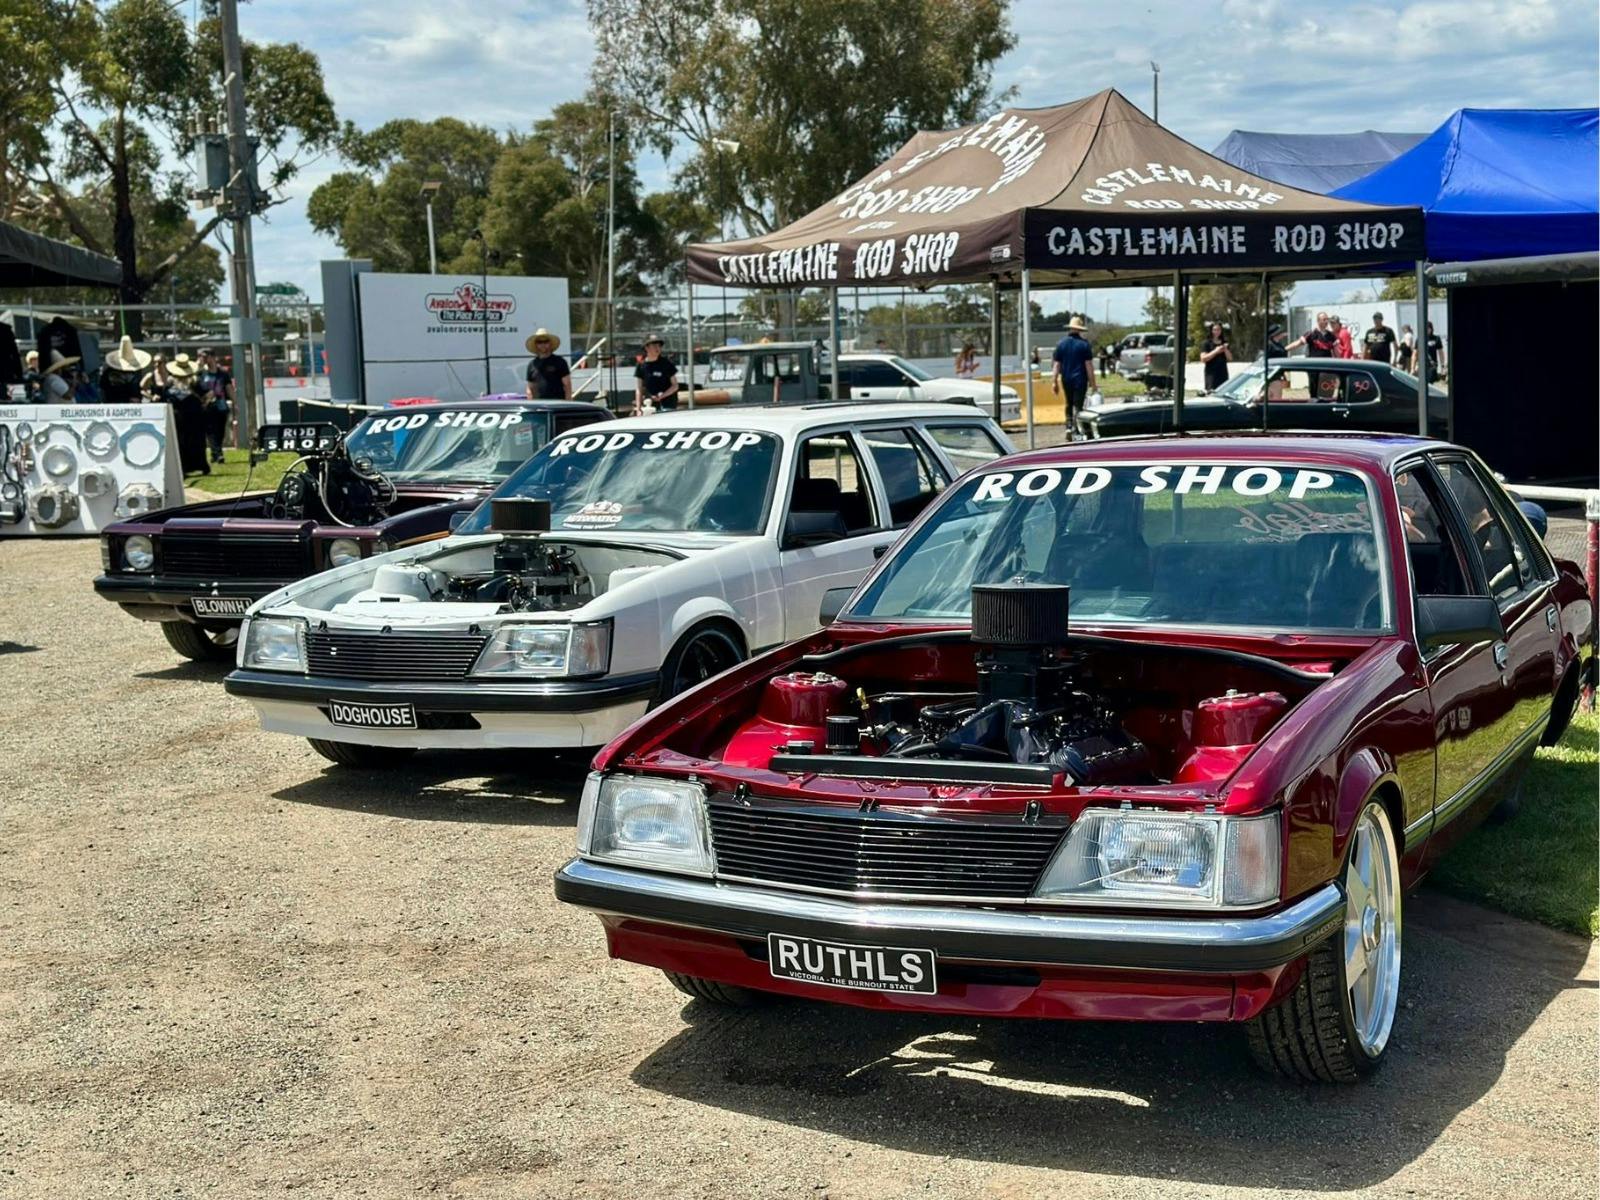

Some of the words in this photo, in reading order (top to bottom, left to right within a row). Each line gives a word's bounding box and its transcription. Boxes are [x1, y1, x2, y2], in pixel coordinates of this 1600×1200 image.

[1081, 163, 1284, 205] CASTLEMAINE
[839, 188, 909, 220] ROD
[898, 185, 983, 214] SHOP
[1123, 199, 1184, 210] ROD
[1189, 199, 1260, 211] SHOP
[1047, 225, 1247, 256] CASTLEMAINE
[1272, 224, 1326, 254] ROD
[1335, 221, 1405, 252] SHOP
[718, 242, 840, 284] CASTLEMAINE
[853, 238, 896, 280] ROD
[901, 231, 960, 276] SHOP
[430, 298, 460, 309] Avalon
[426, 326, 518, 334] avalonracewa.com.au
[60, 408, 105, 418] BELLHOUSINGS
[106, 408, 111, 417] &
[112, 408, 142, 417] ADAPTORS
[366, 413, 429, 435] ROD
[434, 412, 523, 429] SHOP
[283, 427, 316, 438] ROD
[268, 439, 329, 449] SHOP
[550, 432, 635, 457] ROD
[642, 431, 762, 452] SHOP
[972, 467, 1112, 502] ROD
[1133, 466, 1334, 499] SHOP
[333, 704, 413, 725] DOGHOUSE
[778, 939, 925, 984] RUTHLS
[789, 971, 825, 982] VICTORIA
[832, 977, 846, 985] THE
[848, 980, 887, 989] BURNOUT
[889, 983, 915, 991] STATE
